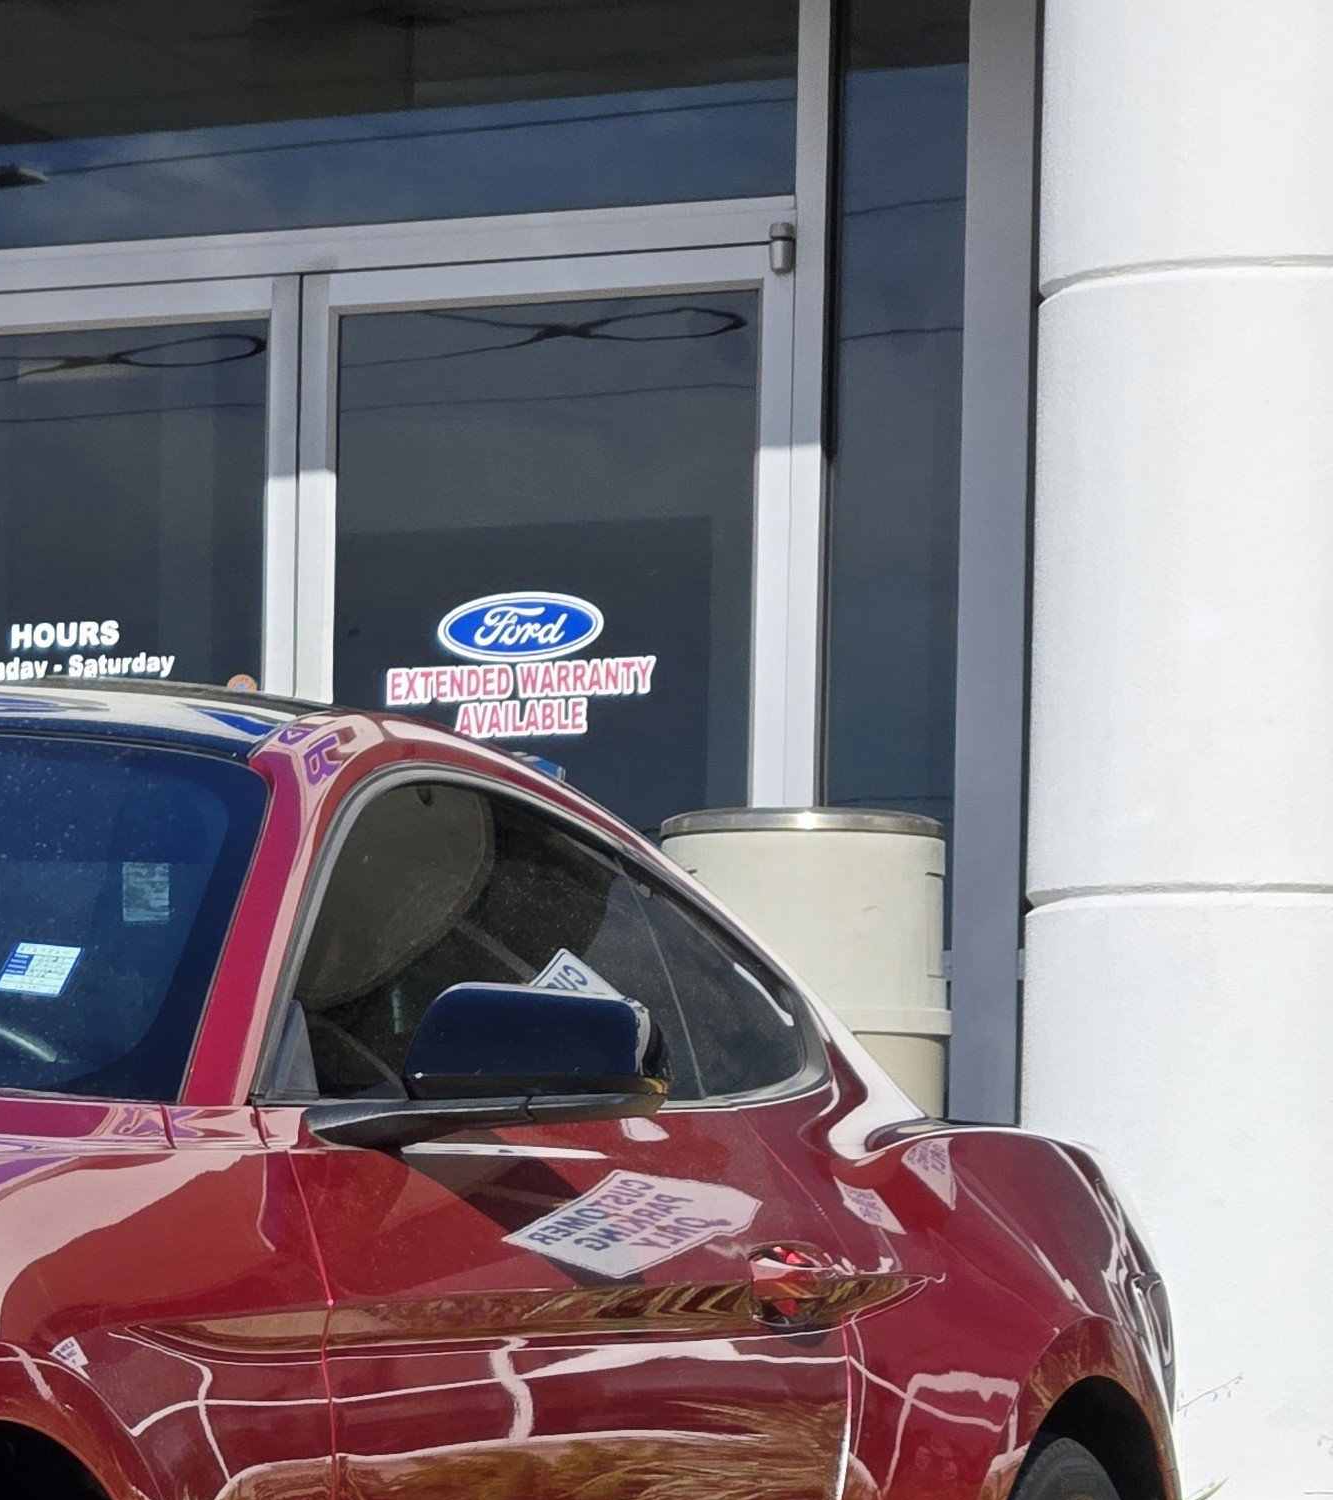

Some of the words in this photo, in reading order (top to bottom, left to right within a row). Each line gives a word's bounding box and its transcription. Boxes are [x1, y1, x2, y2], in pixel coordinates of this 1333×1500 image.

[10, 620, 120, 649] HOURS
[473, 604, 569, 646] Ford
[68, 652, 175, 678] Saturday
[388, 666, 512, 703] EXTENDED
[518, 658, 654, 695] WARRANTY
[457, 700, 585, 735] AVAILABLE
